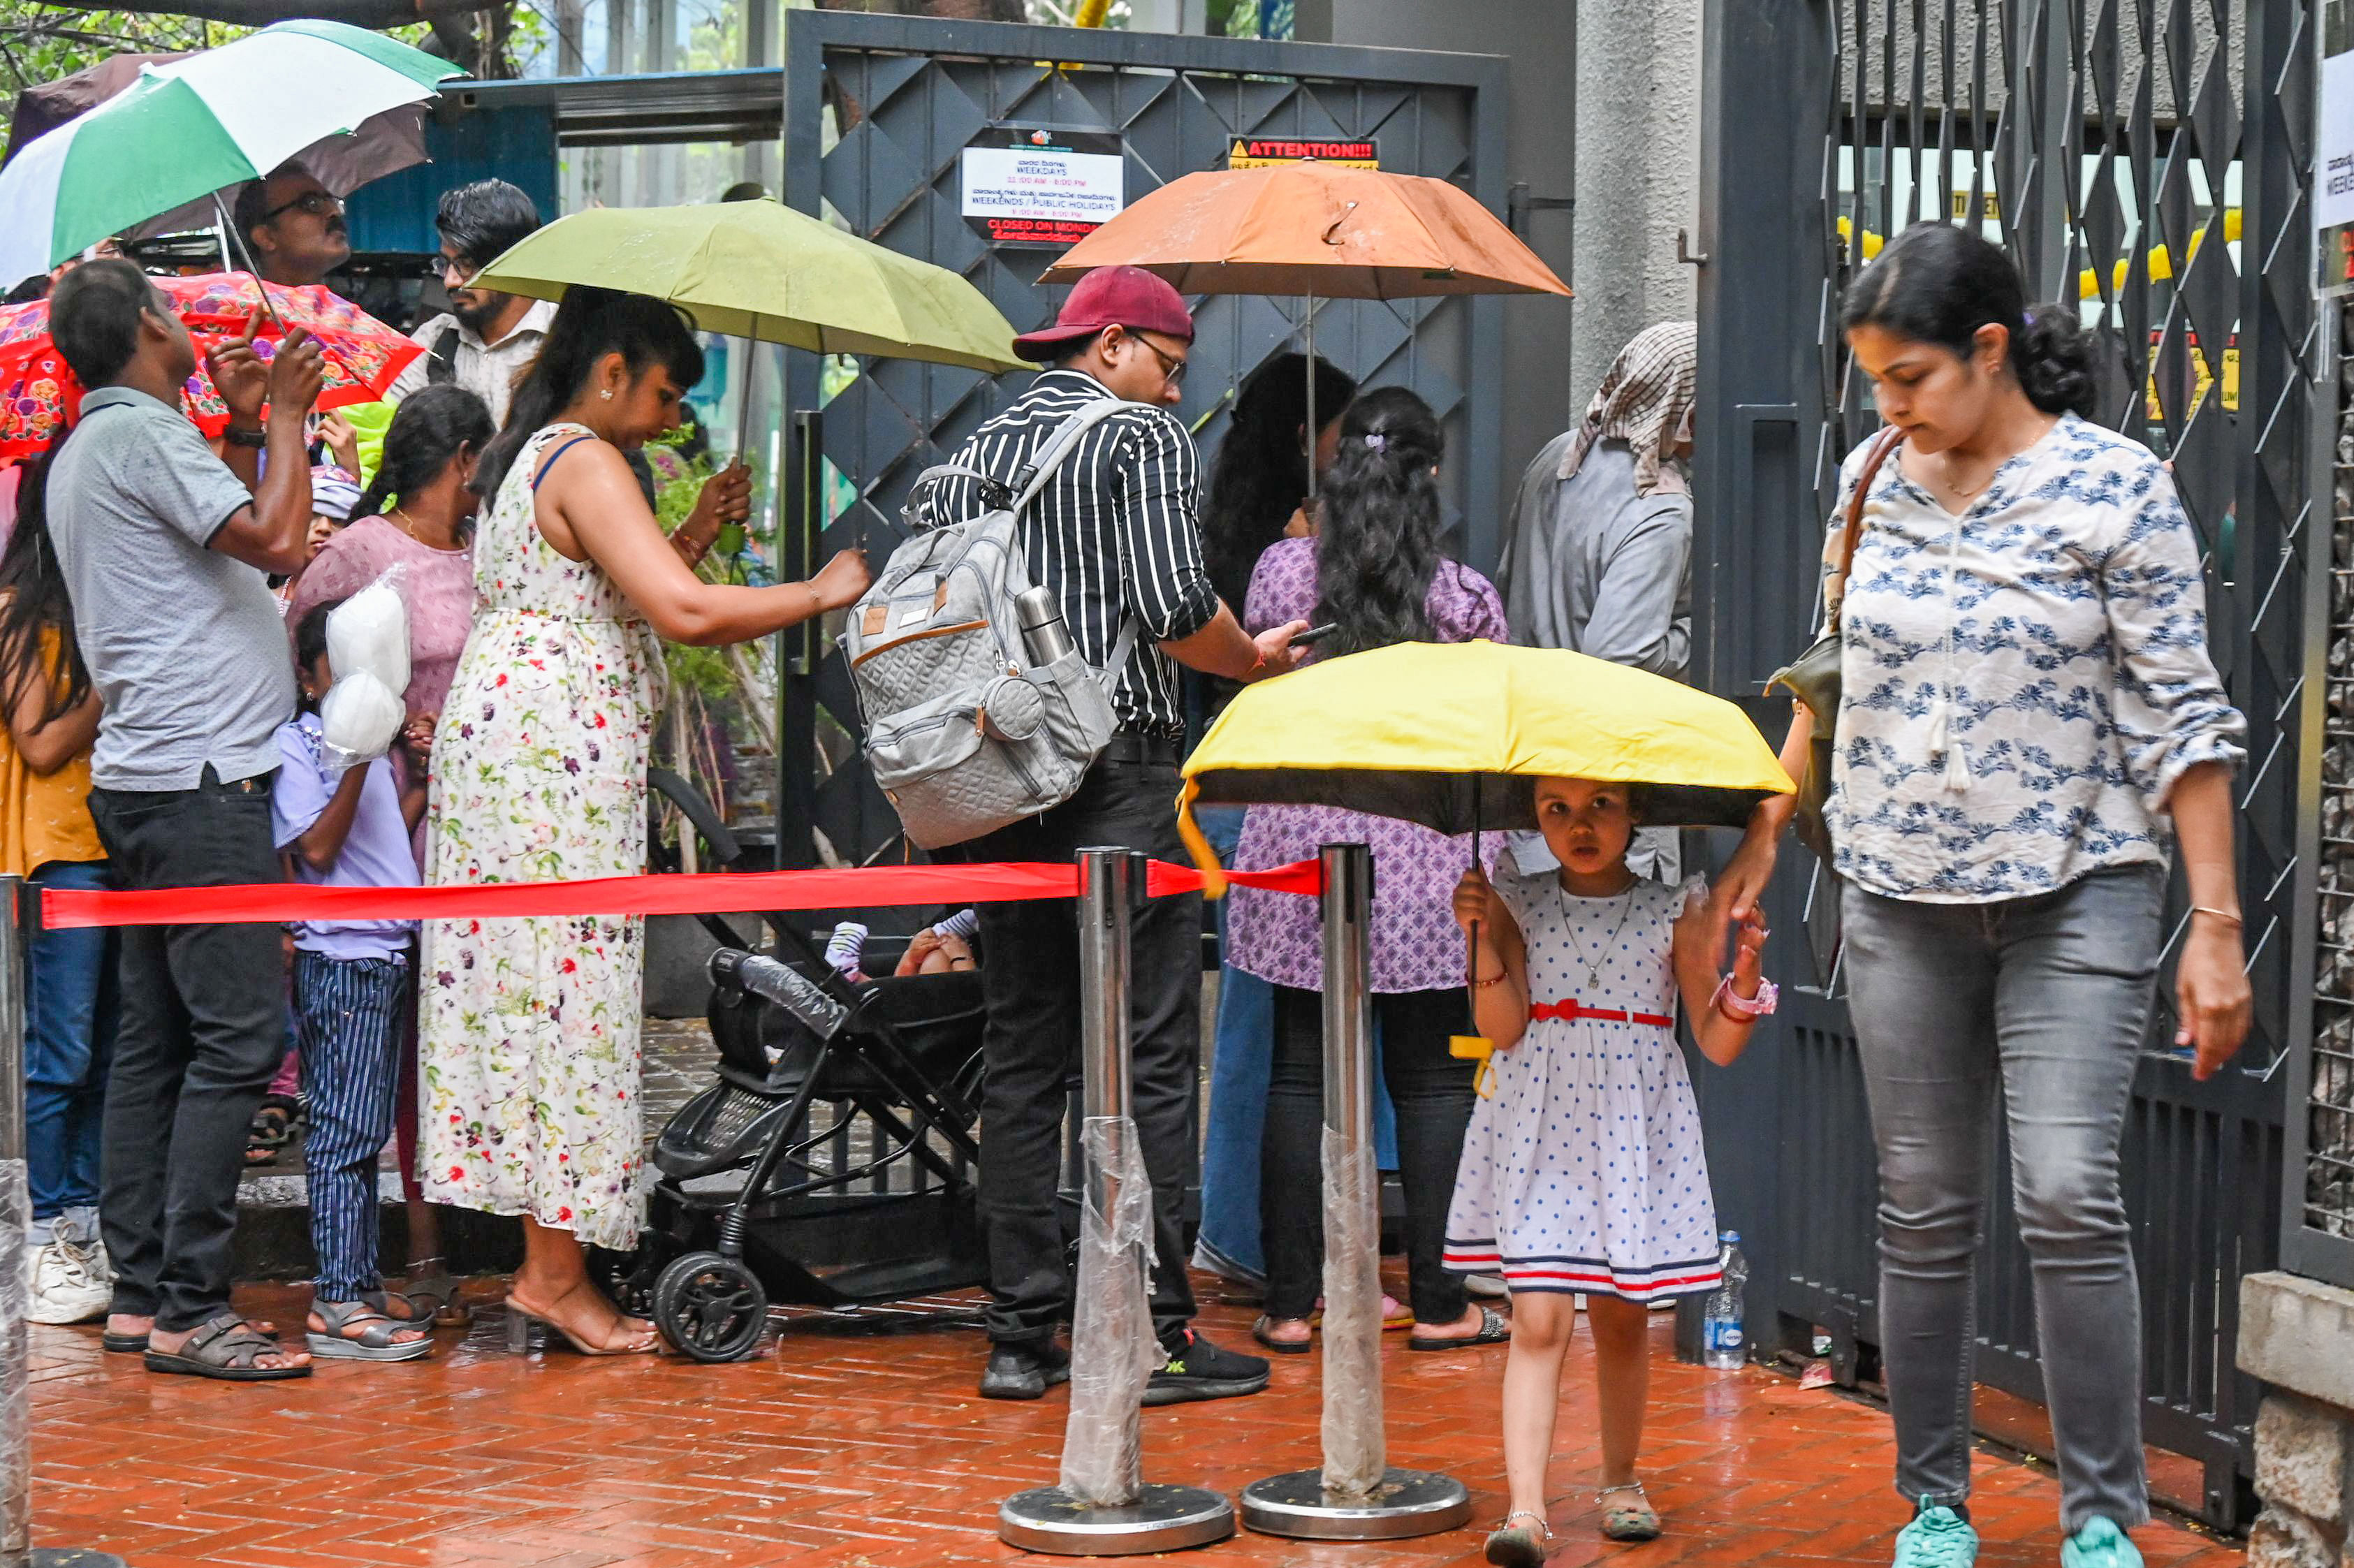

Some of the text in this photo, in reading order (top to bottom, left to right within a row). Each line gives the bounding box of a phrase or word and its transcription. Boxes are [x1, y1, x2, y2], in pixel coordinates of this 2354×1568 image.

[1249, 141, 1373, 157] ATTENTION!!!
[1017, 167, 1067, 176] WEEKDAYS
[972, 197, 1024, 206] WEEKENDS
[1033, 199, 1067, 208] PUBLIC
[1069, 202, 1116, 211] HOLIDAYS
[988, 219, 1101, 233] CLOSED ON MONDA
